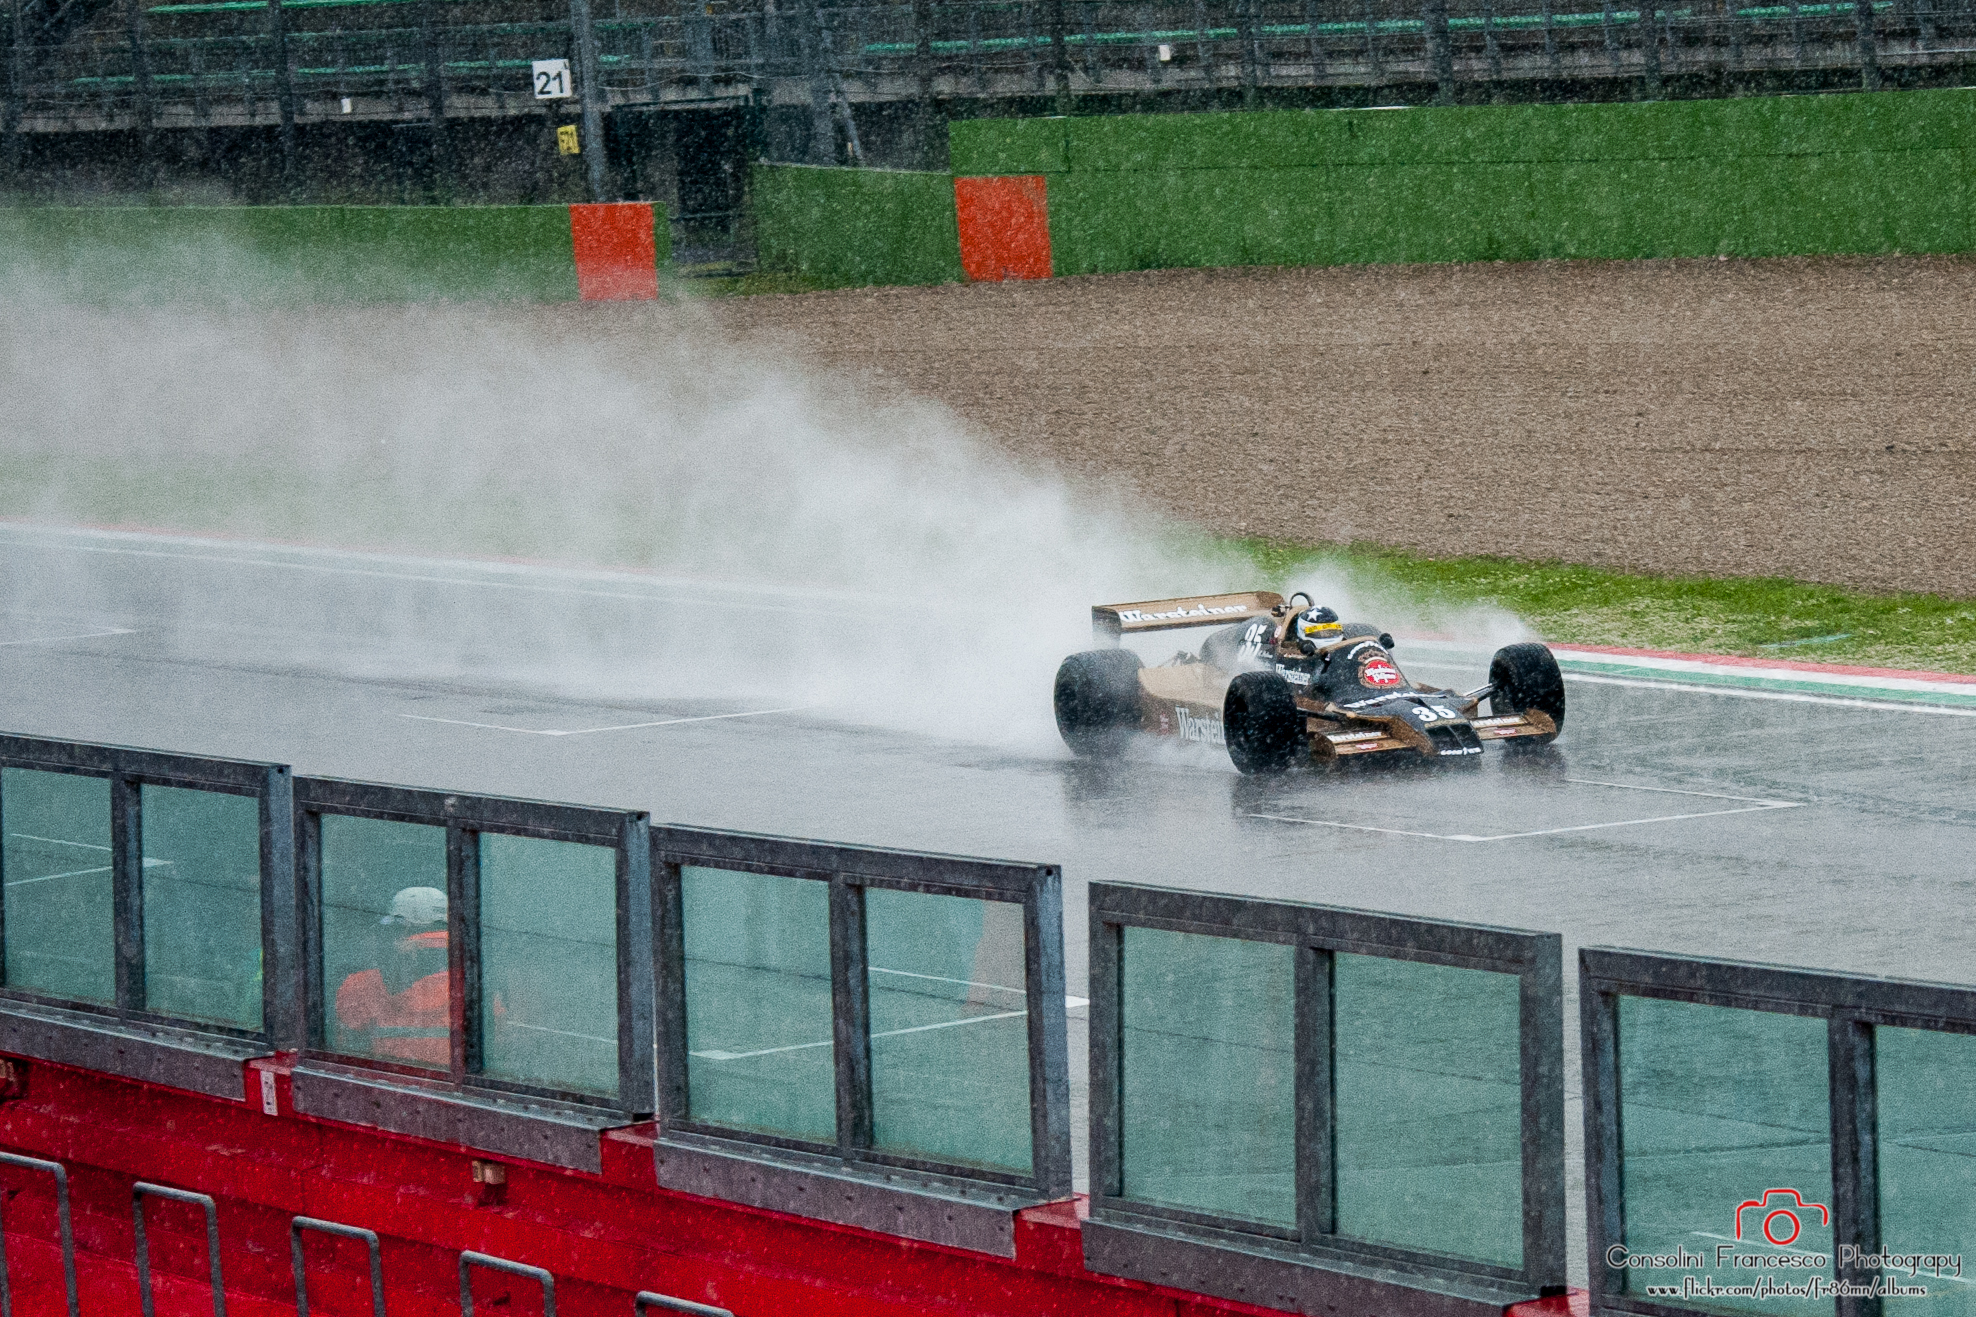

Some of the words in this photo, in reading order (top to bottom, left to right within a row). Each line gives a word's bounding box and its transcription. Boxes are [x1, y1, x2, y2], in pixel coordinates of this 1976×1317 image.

[536, 71, 564, 95] 21
[1119, 604, 1247, 623] Warsteiner
[1412, 705, 1456, 722] 35
